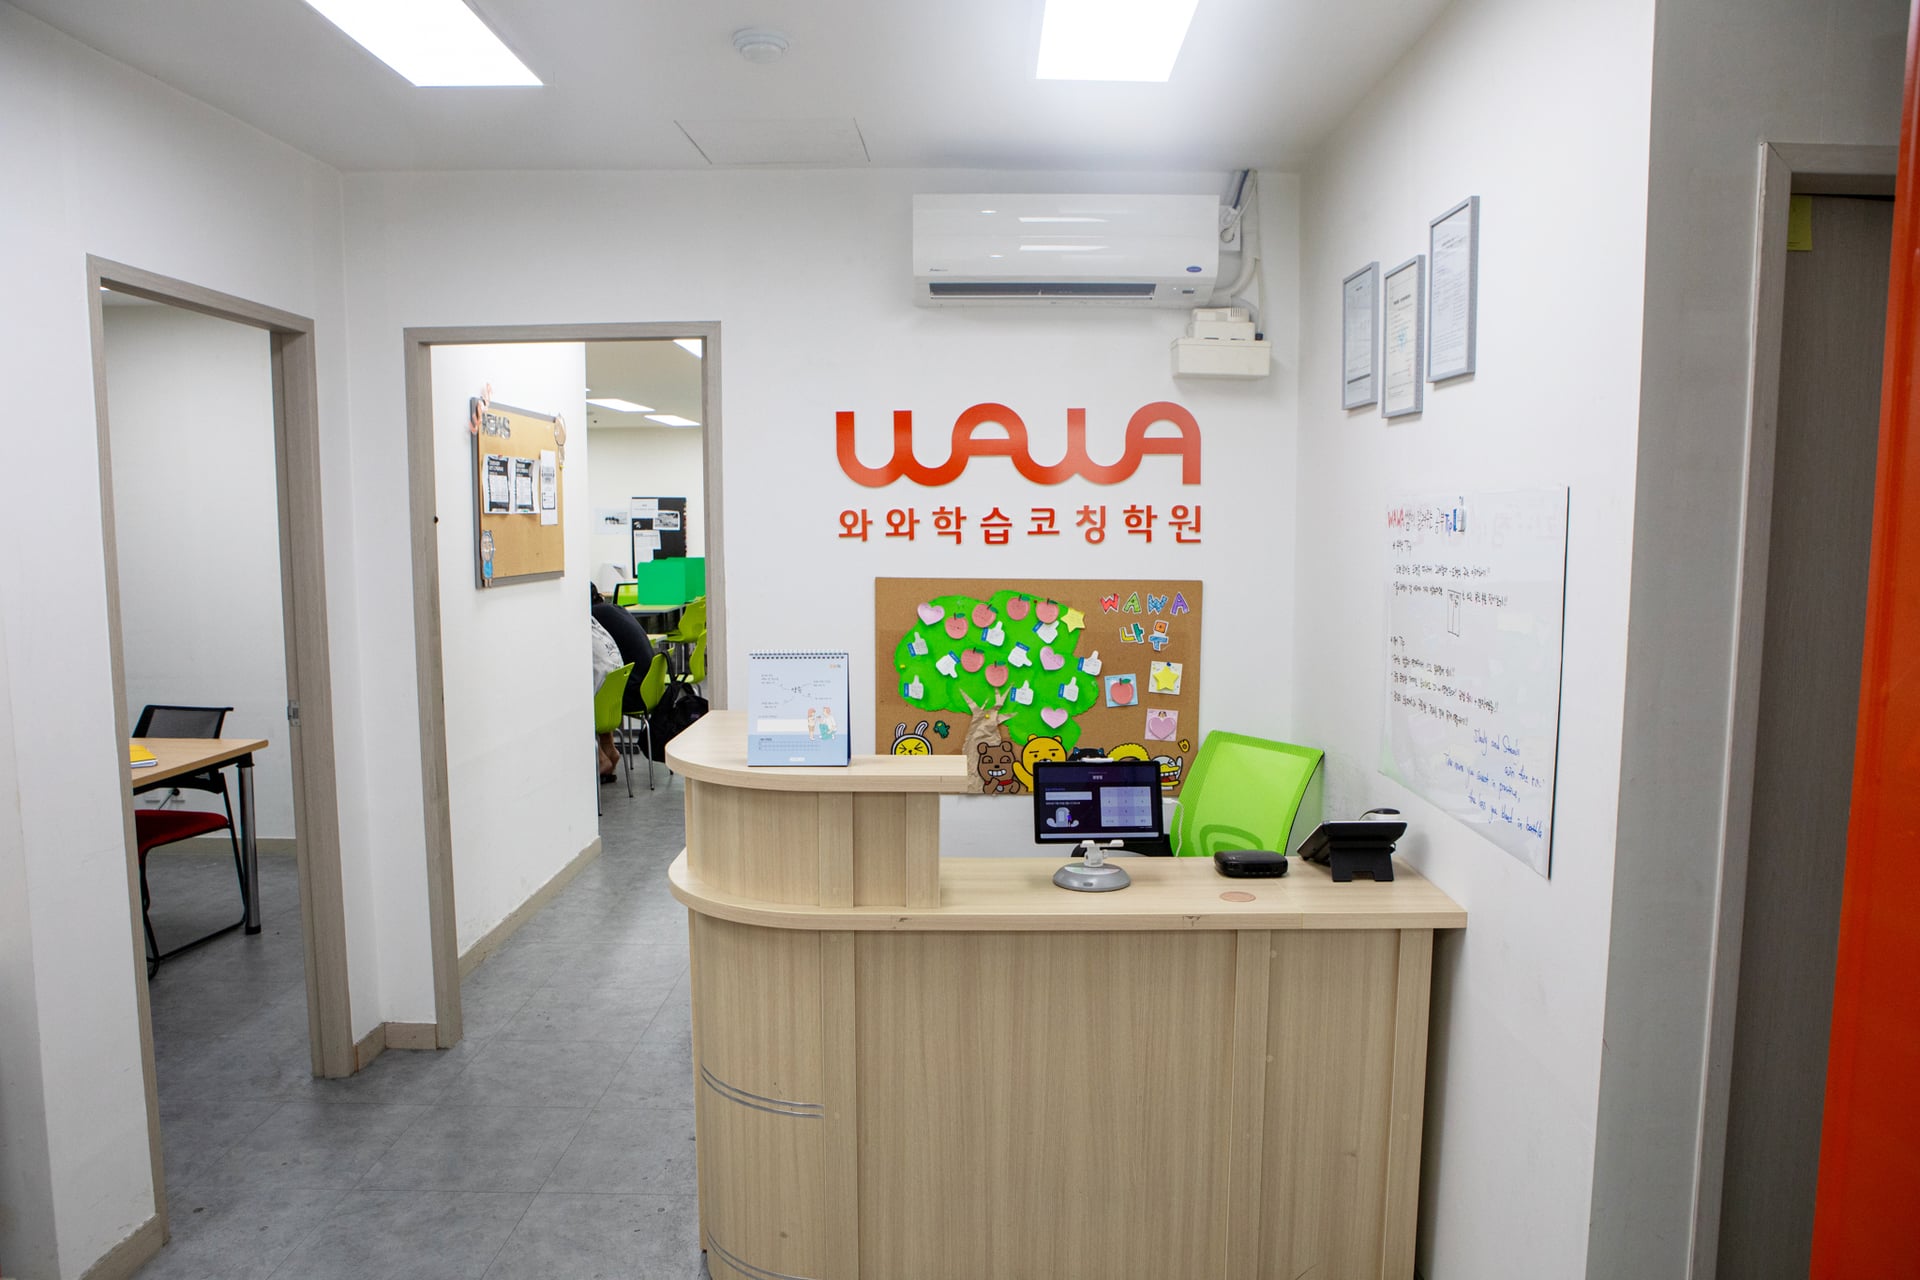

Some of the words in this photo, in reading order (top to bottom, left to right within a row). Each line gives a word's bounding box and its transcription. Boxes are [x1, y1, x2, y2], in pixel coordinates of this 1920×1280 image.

[836, 401, 1202, 488] WAWA
[838, 504, 1202, 545] 와와학습코칭학원
[1100, 591, 1190, 616] WAWA
[1119, 620, 1169, 651] 나무
